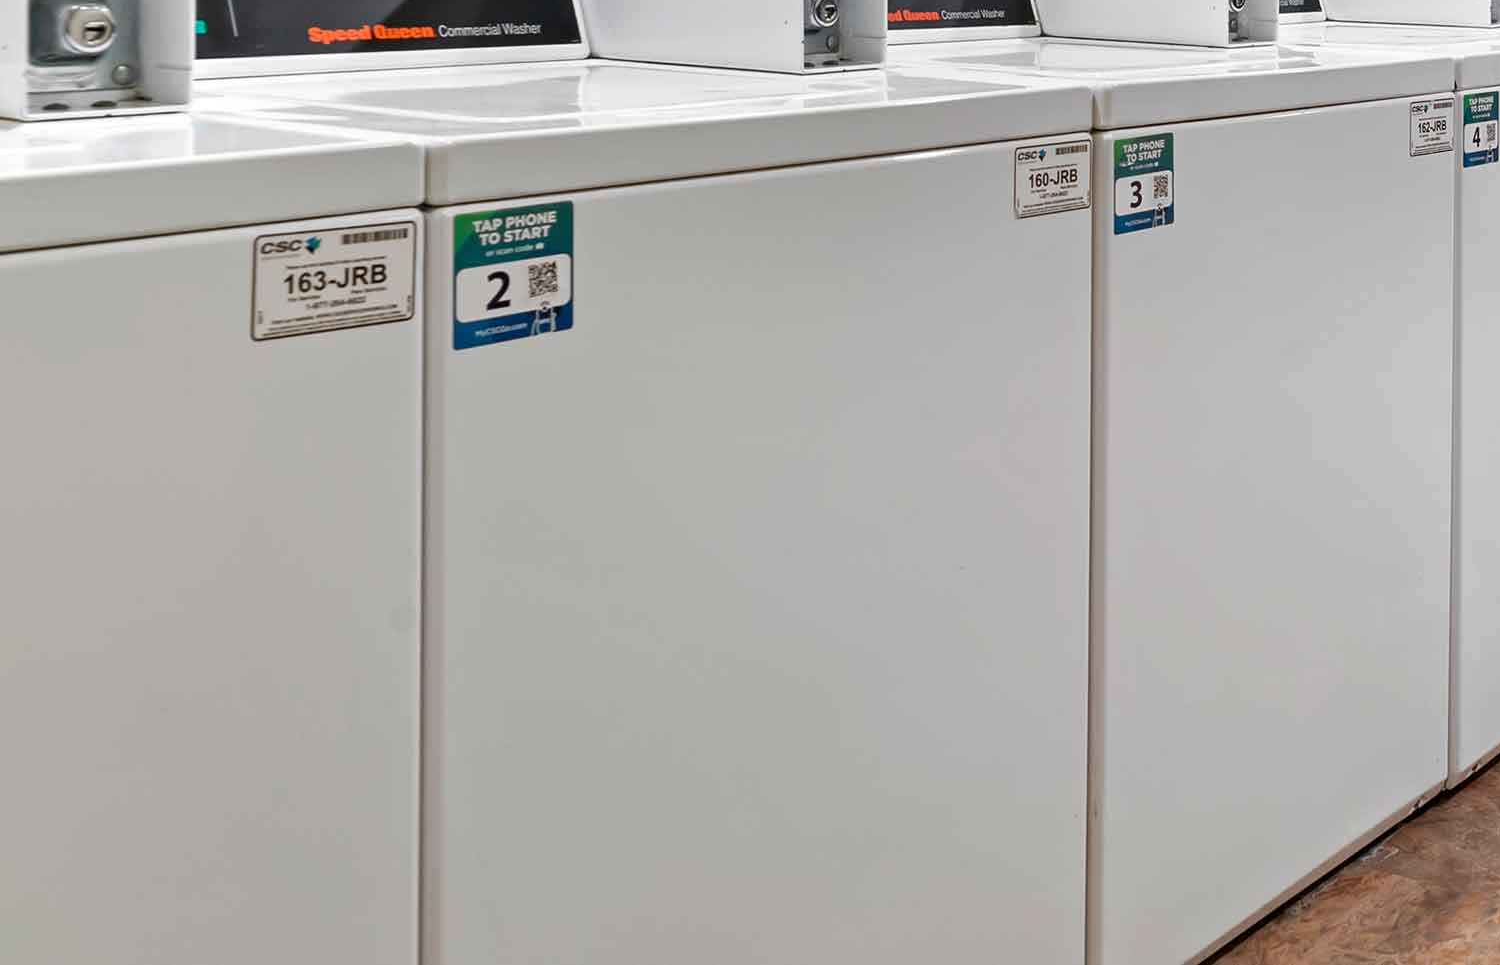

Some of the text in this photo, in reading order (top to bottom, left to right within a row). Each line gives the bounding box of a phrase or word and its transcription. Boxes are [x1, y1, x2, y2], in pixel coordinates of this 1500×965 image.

[903, 9, 940, 22] Queen
[981, 9, 1006, 19] Washer
[307, 23, 542, 44] Speed Queen Commercial Washer
[1418, 119, 1447, 134] 162-JRB
[1473, 127, 1481, 147] 4
[1018, 151, 1037, 161] CSC
[1123, 140, 1165, 154] TAP PHONE
[1126, 149, 1162, 164] TO START
[1029, 169, 1078, 188] 160-JRB
[1130, 180, 1142, 209] 3
[472, 211, 558, 233] TAP PHONE
[479, 225, 551, 246] TO START
[260, 239, 303, 255] CSC
[283, 264, 388, 294] 163-JRB
[486, 271, 511, 311] 2
